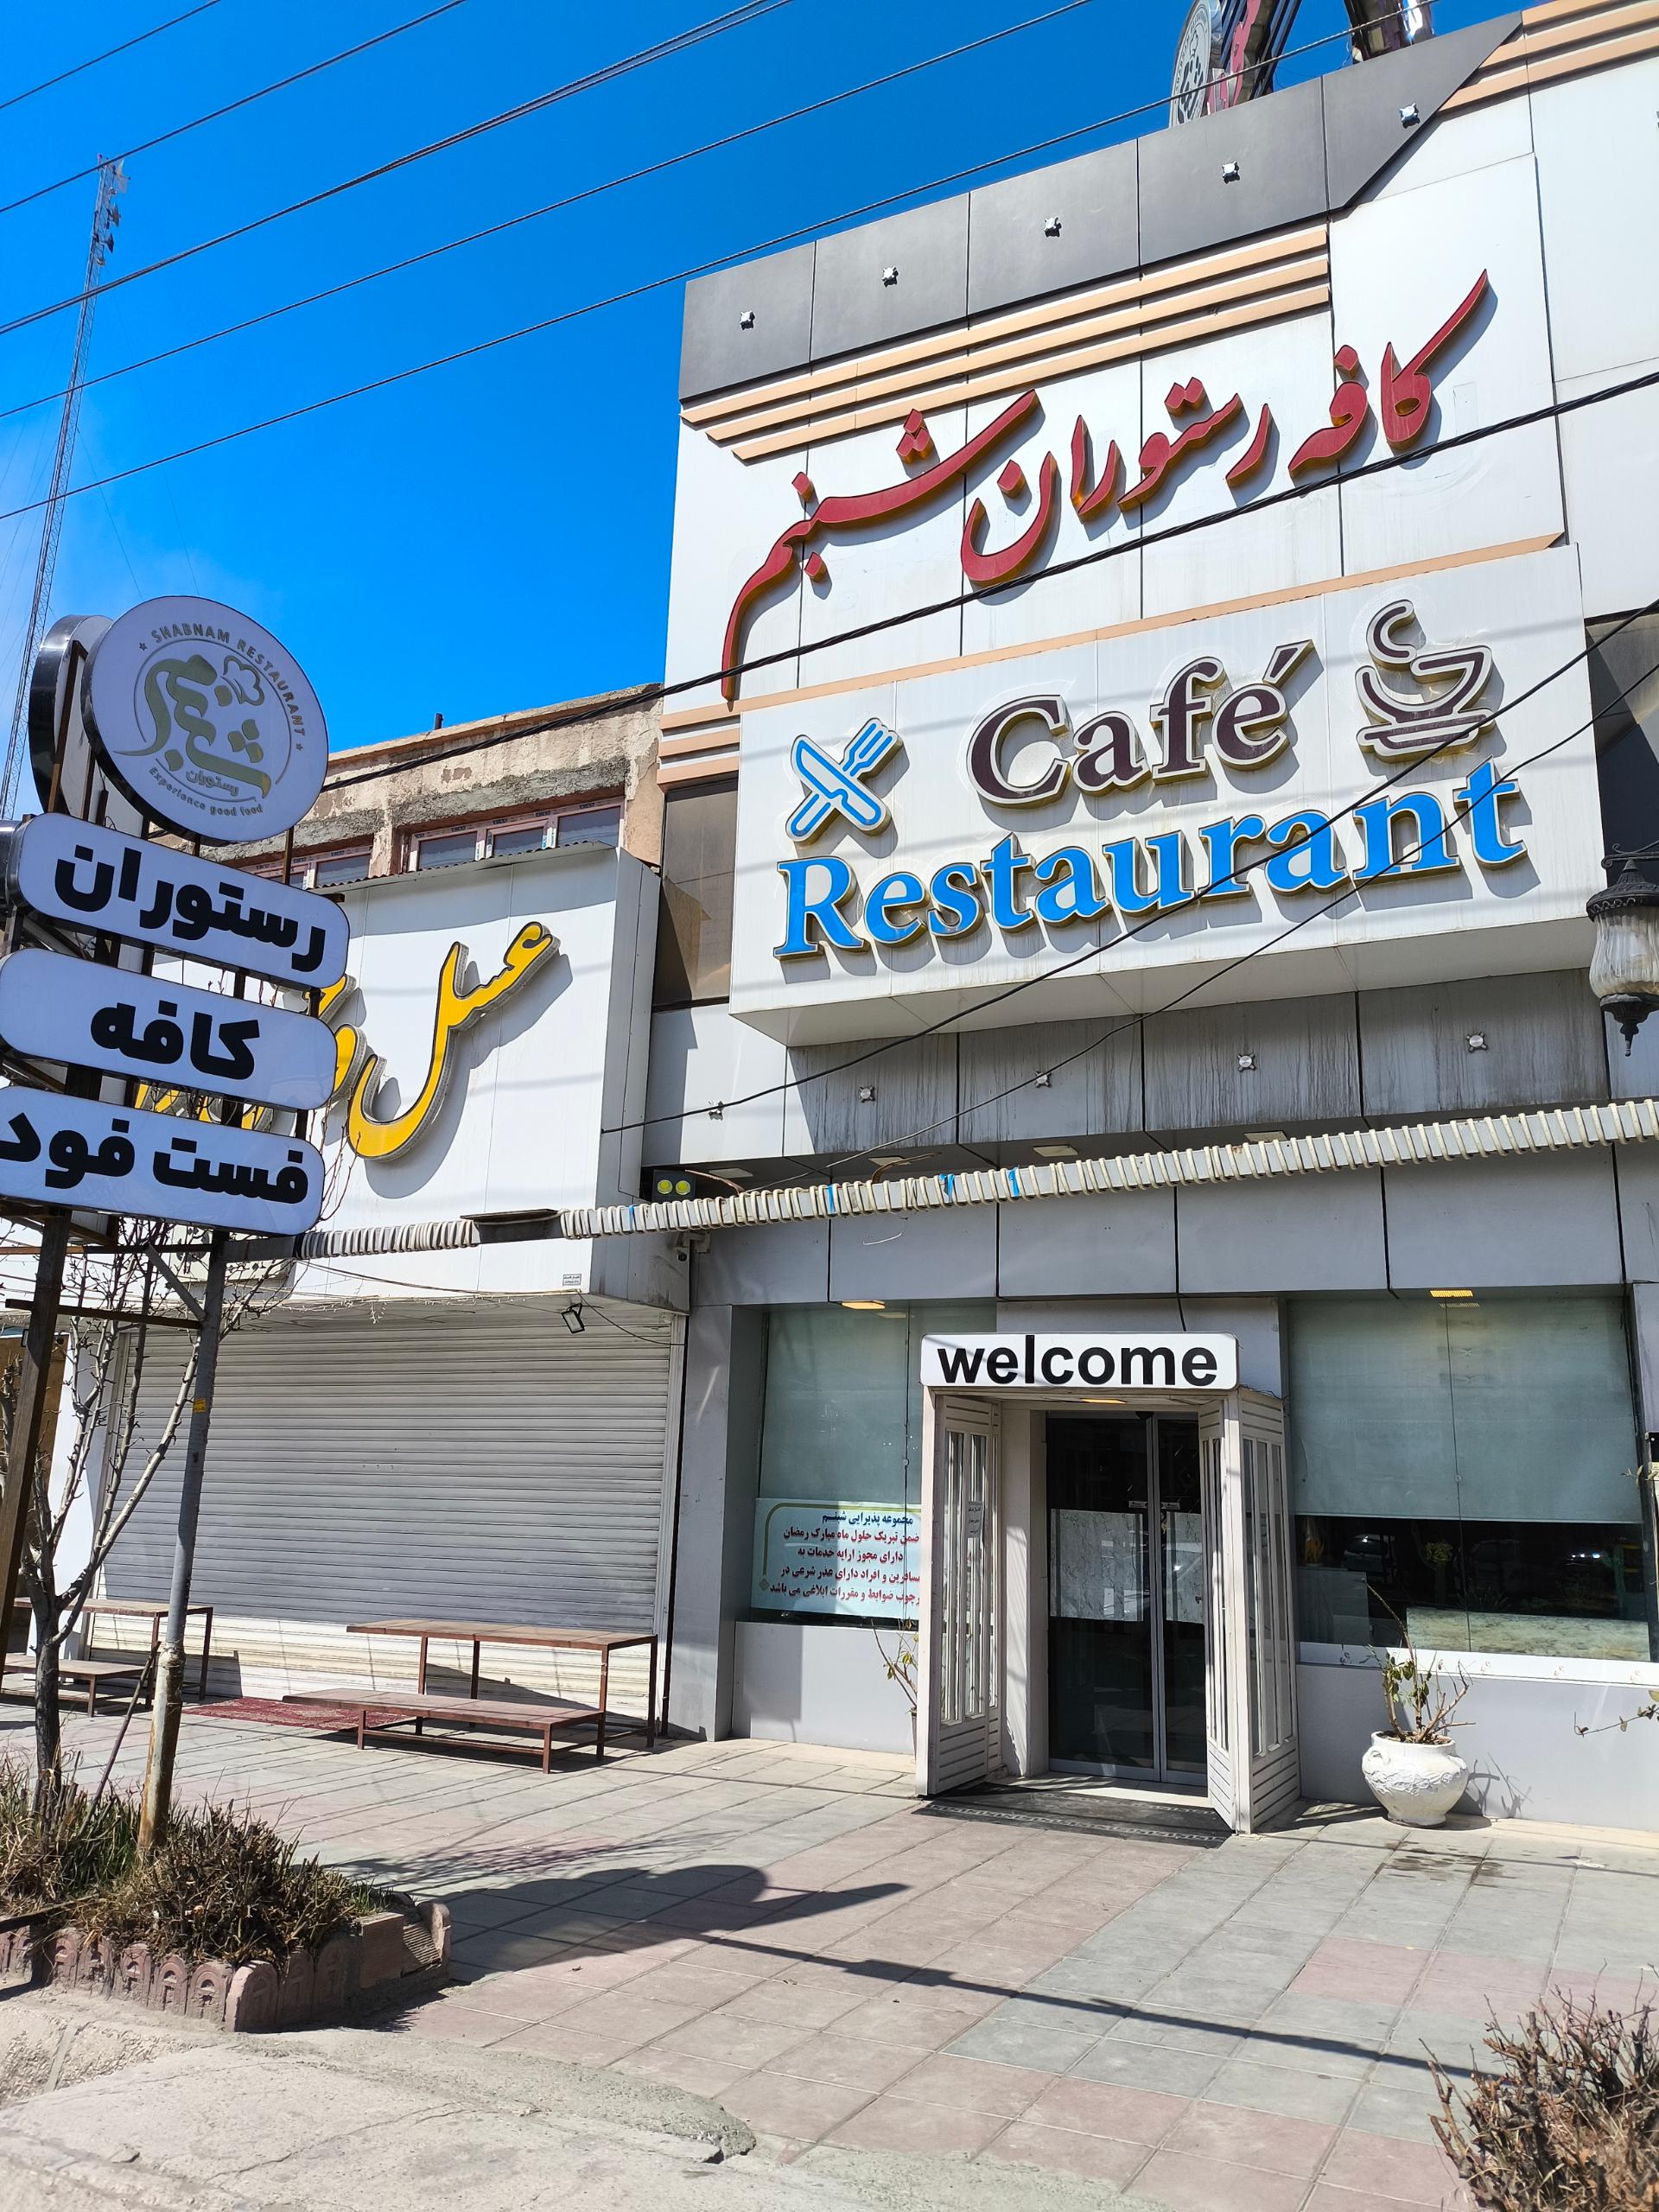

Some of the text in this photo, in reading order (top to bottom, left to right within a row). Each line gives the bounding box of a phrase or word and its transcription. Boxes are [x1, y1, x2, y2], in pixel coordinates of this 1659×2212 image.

[721, 270, 1490, 702] کافه رستوران شبنم
[151, 624, 306, 736] SHABNAM RESTAURANT
[965, 639, 1316, 810] Café
[185, 770, 239, 797] رستوران
[149, 766, 263, 817] Experience good food
[772, 753, 1529, 961] Restaurant
[54, 844, 327, 973] رستوران
[90, 1000, 262, 1081] کافه
[0, 1112, 310, 1205] فست فود
[937, 1334, 1218, 1387] welcome
[849, 1511, 880, 1527] پذیرایی
[881, 1514, 913, 1528] مجموعه
[783, 1526, 919, 1545] ضمن تبریک حلول ماه مبارک رمضان
[798, 1548, 805, 1556] به
[807, 1547, 835, 1559] خدمات
[856, 1552, 878, 1564] مجوز
[879, 1550, 904, 1564] دارای
[780, 1565, 791, 1578] در
[791, 1565, 816, 1578] شرعی
[817, 1567, 833, 1580] عذر
[835, 1567, 859, 1581] دارای
[861, 1570, 880, 1583] افراد
[769, 1580, 788, 1595] باشد
[788, 1586, 801, 1598] می
[803, 1586, 828, 1599] ابلاغی
[830, 1587, 859, 1600] مقررات
[868, 1588, 893, 1603] ضوابط
